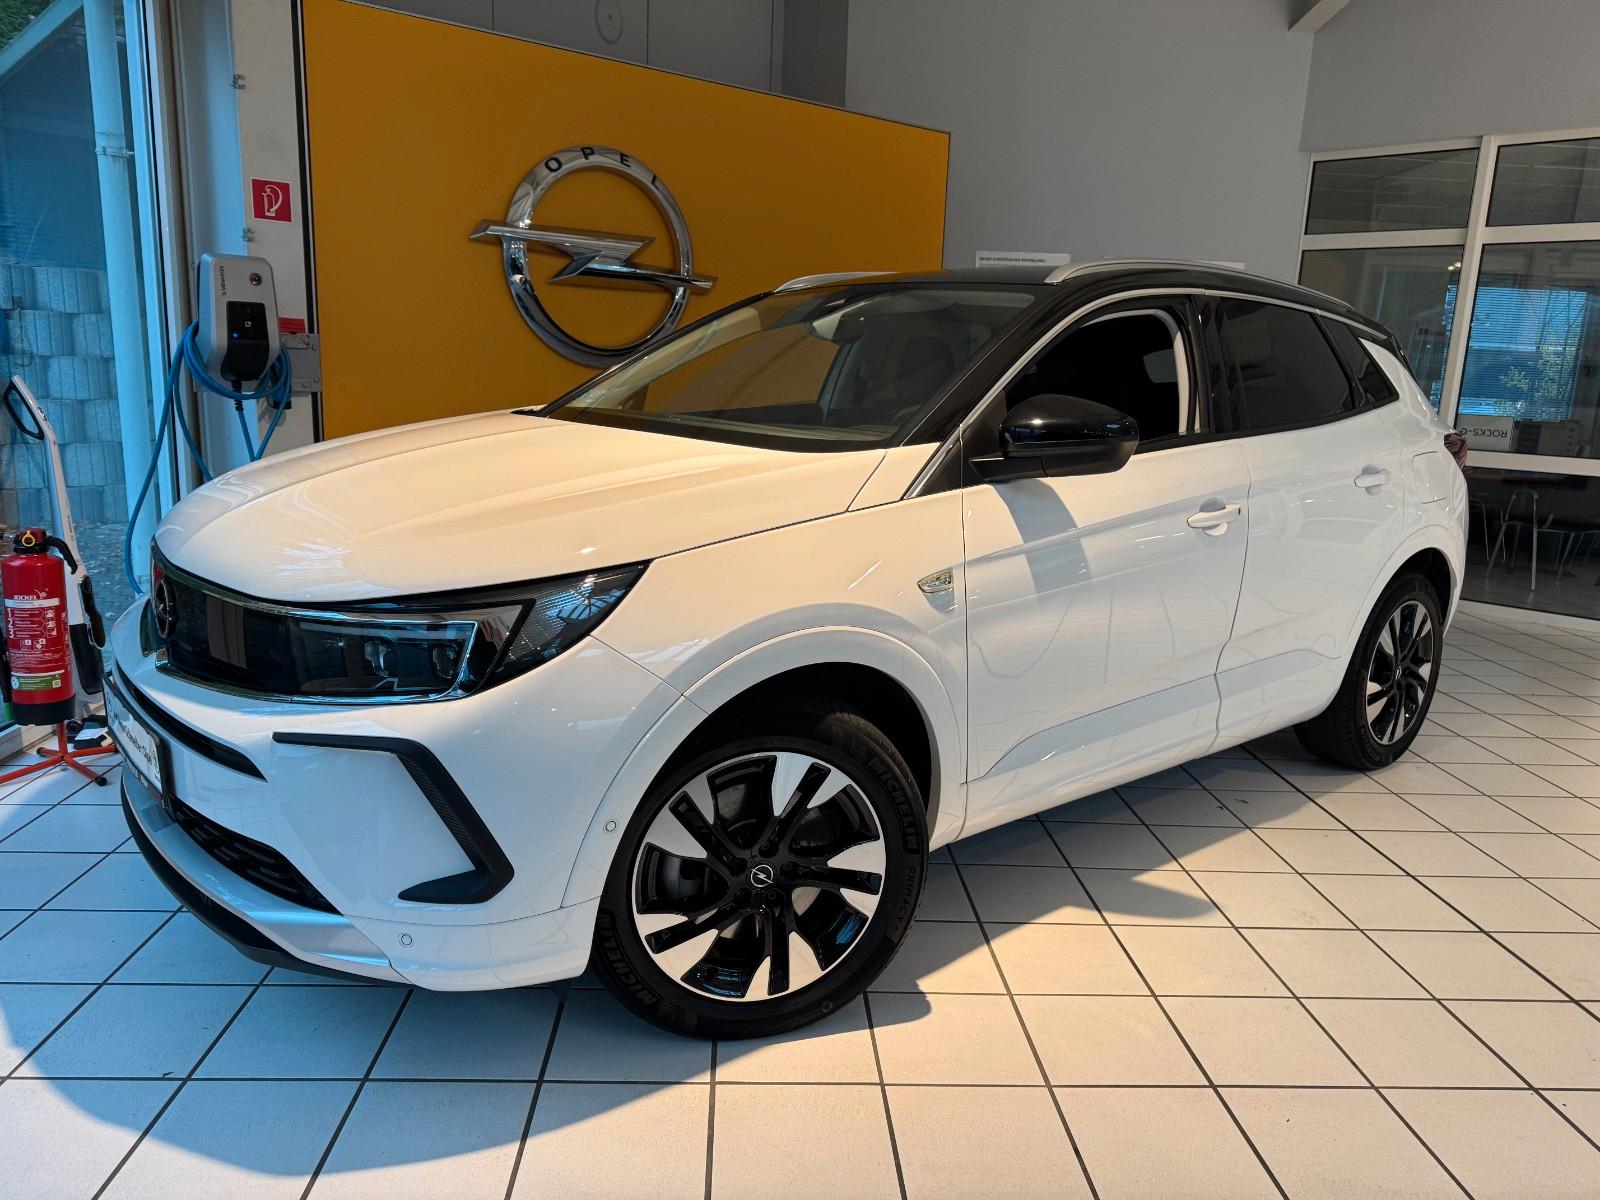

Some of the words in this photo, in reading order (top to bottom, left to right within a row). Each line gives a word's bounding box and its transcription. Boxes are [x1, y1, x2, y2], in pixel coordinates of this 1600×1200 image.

[544, 146, 659, 189] OPEL
[7, 608, 12, 617] 1
[8, 618, 13, 628] 2
[9, 628, 14, 638] 3
[868, 757, 920, 853] MICHELIN
[597, 909, 658, 1005] MICHELIN
